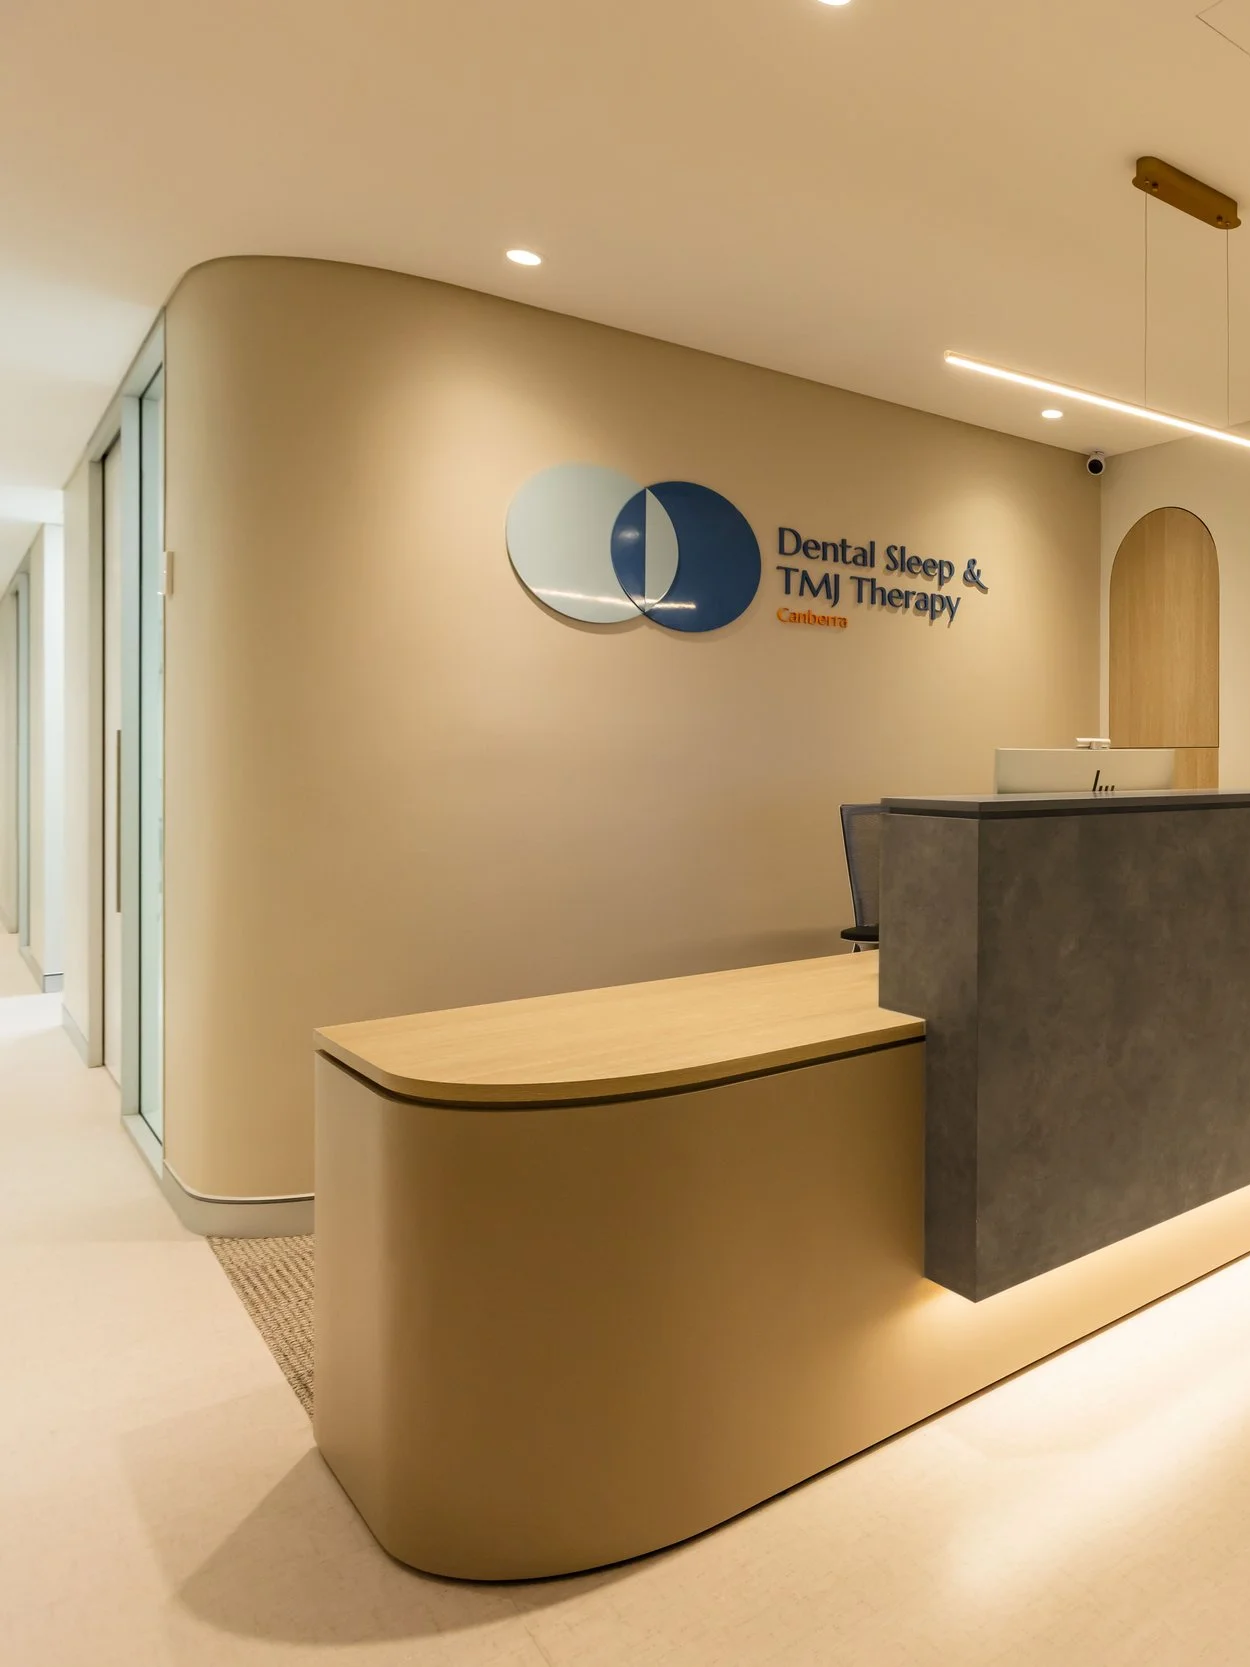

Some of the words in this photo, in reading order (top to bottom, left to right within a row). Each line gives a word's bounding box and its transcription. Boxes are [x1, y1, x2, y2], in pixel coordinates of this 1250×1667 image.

[778, 526, 876, 568] Dental
[885, 544, 955, 587] Sleep
[963, 558, 989, 590] &
[776, 565, 840, 608] TMJ
[850, 576, 962, 622] Therapy
[776, 607, 848, 629] Canberra
